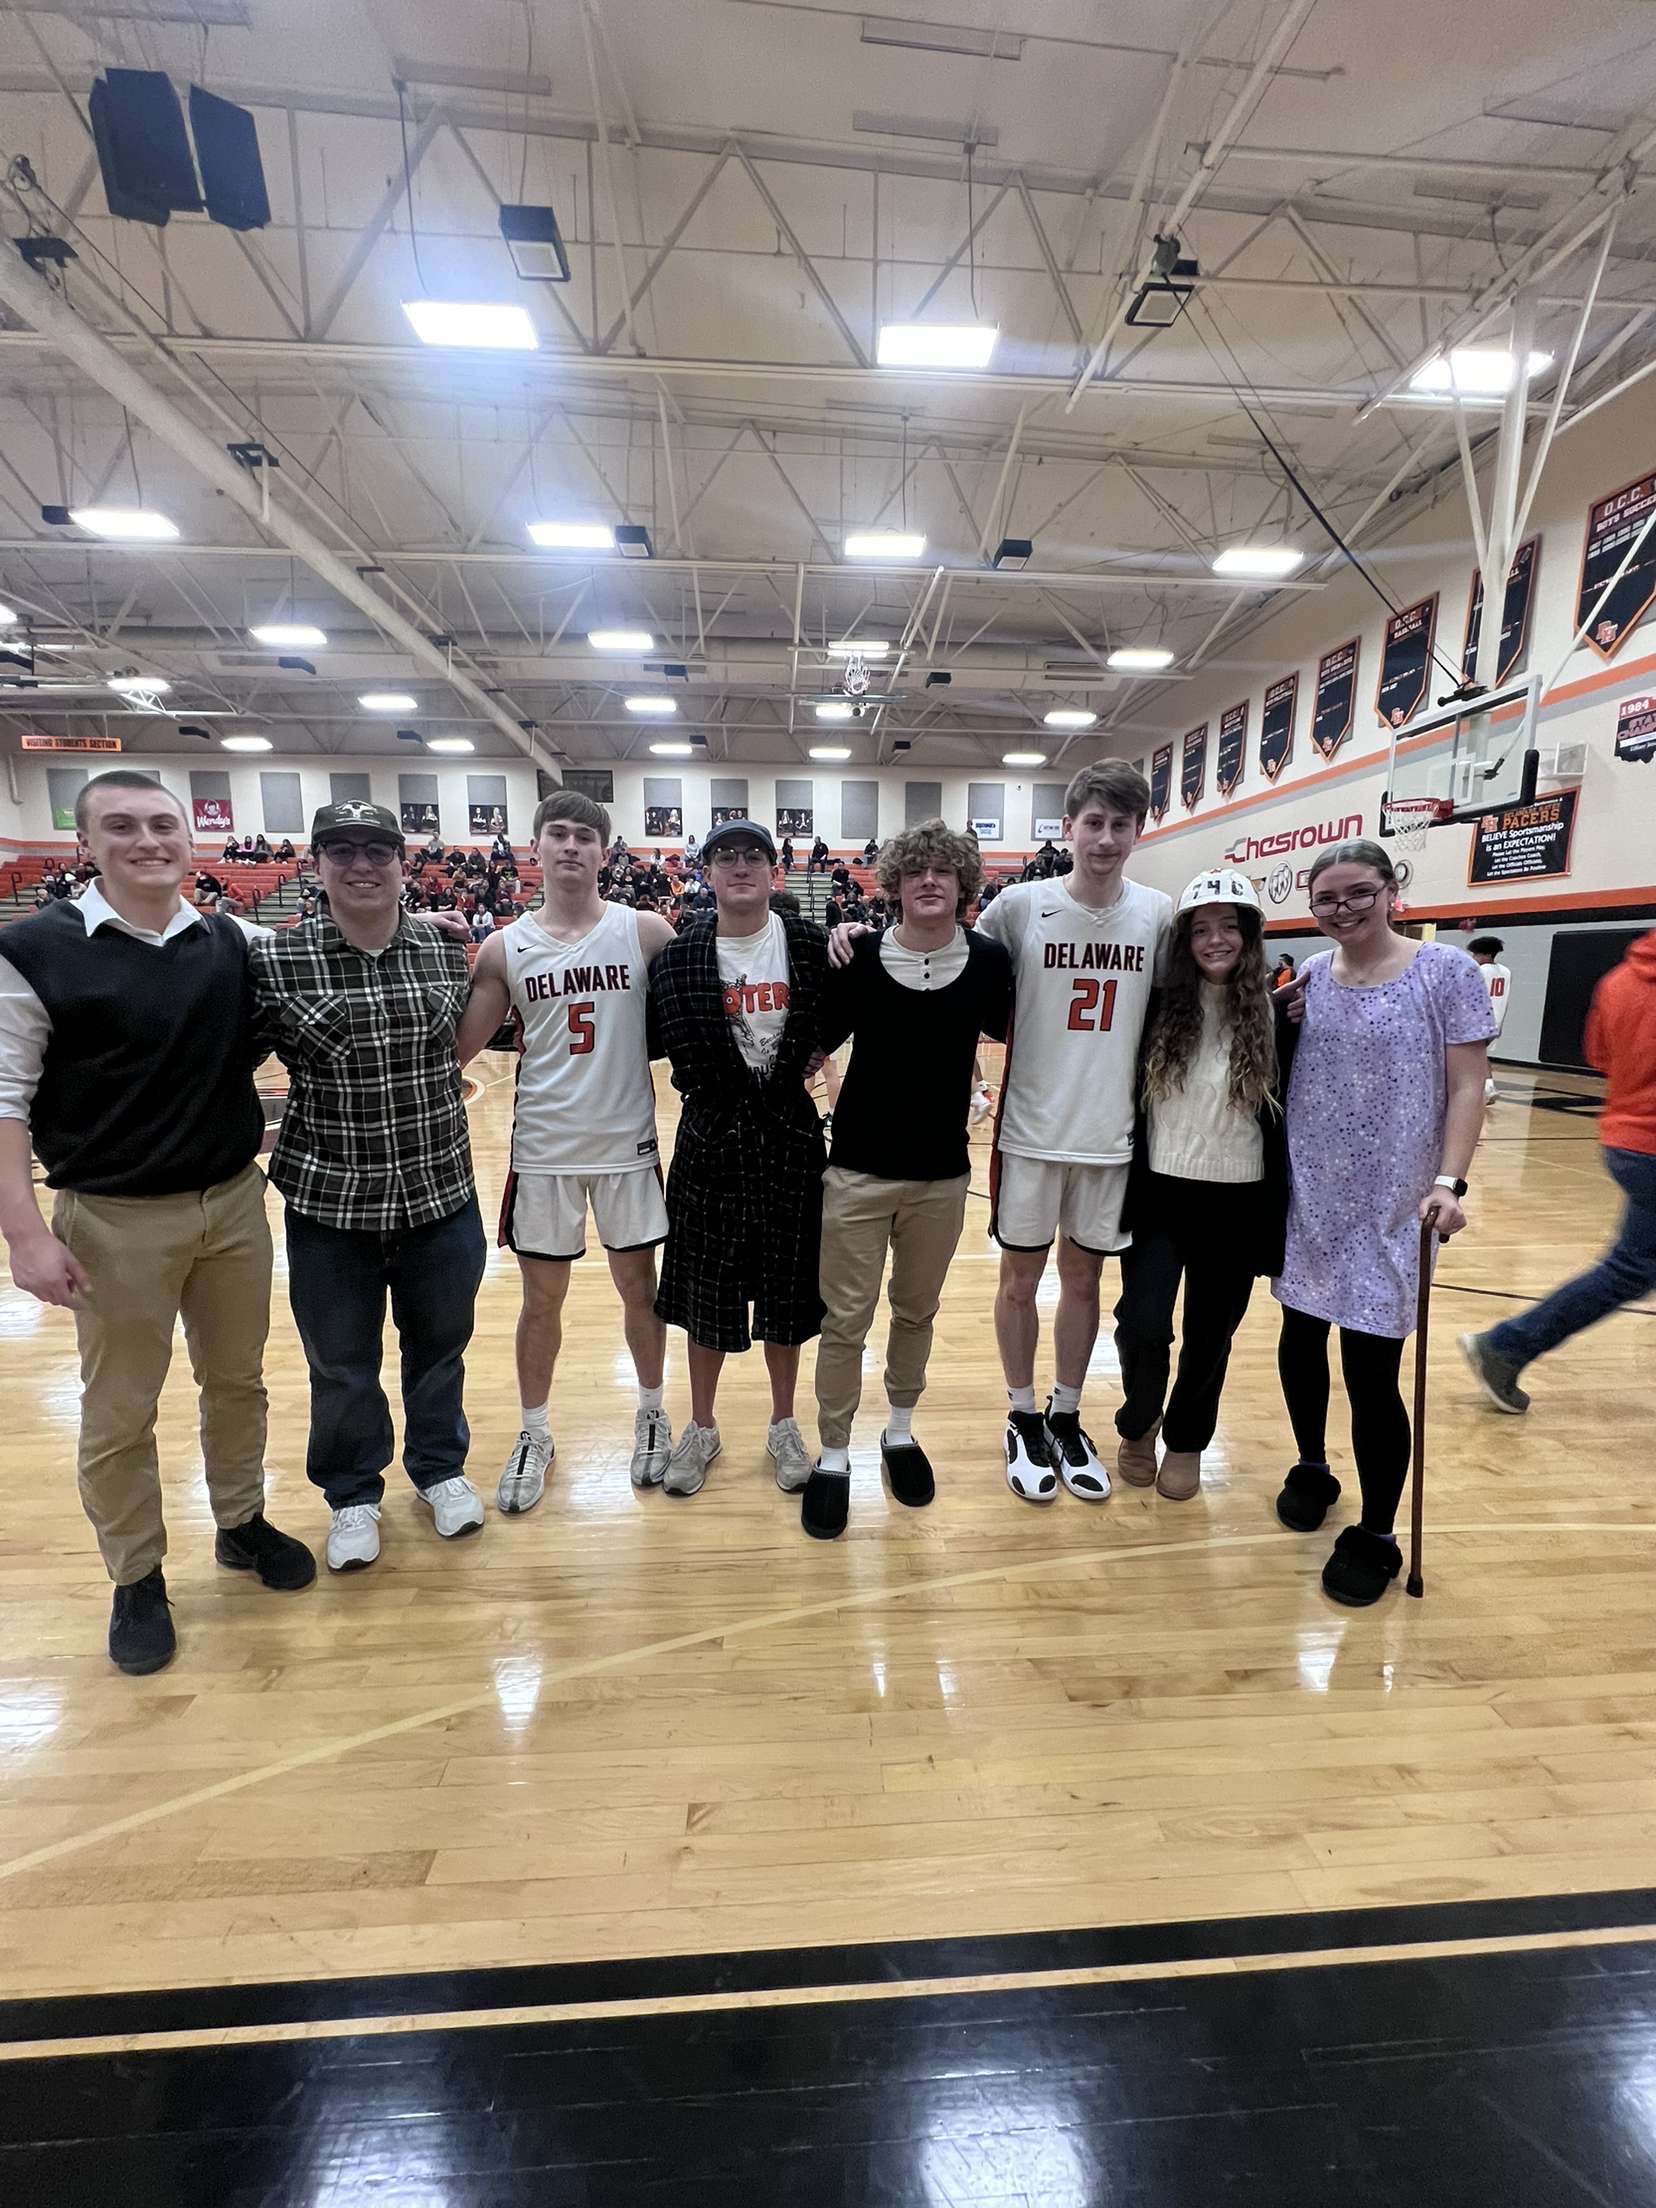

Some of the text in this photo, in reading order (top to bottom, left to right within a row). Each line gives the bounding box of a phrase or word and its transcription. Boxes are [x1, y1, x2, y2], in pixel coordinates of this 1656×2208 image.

[1620, 699, 1650, 717] 1984
[196, 814, 231, 829] Wendy's
[1481, 830, 1508, 843] BELIEVE
[1508, 821, 1564, 838] Sportsmanship
[1503, 808, 1560, 830] PACERS
[1224, 814, 1364, 864] Chesrown
[1485, 832, 1557, 852] is an EXPECTATION!
[1043, 942, 1145, 972] DELAWARE
[524, 964, 631, 1003] DELAWARE
[1067, 978, 1118, 1032] 21
[568, 1001, 595, 1056] 5
